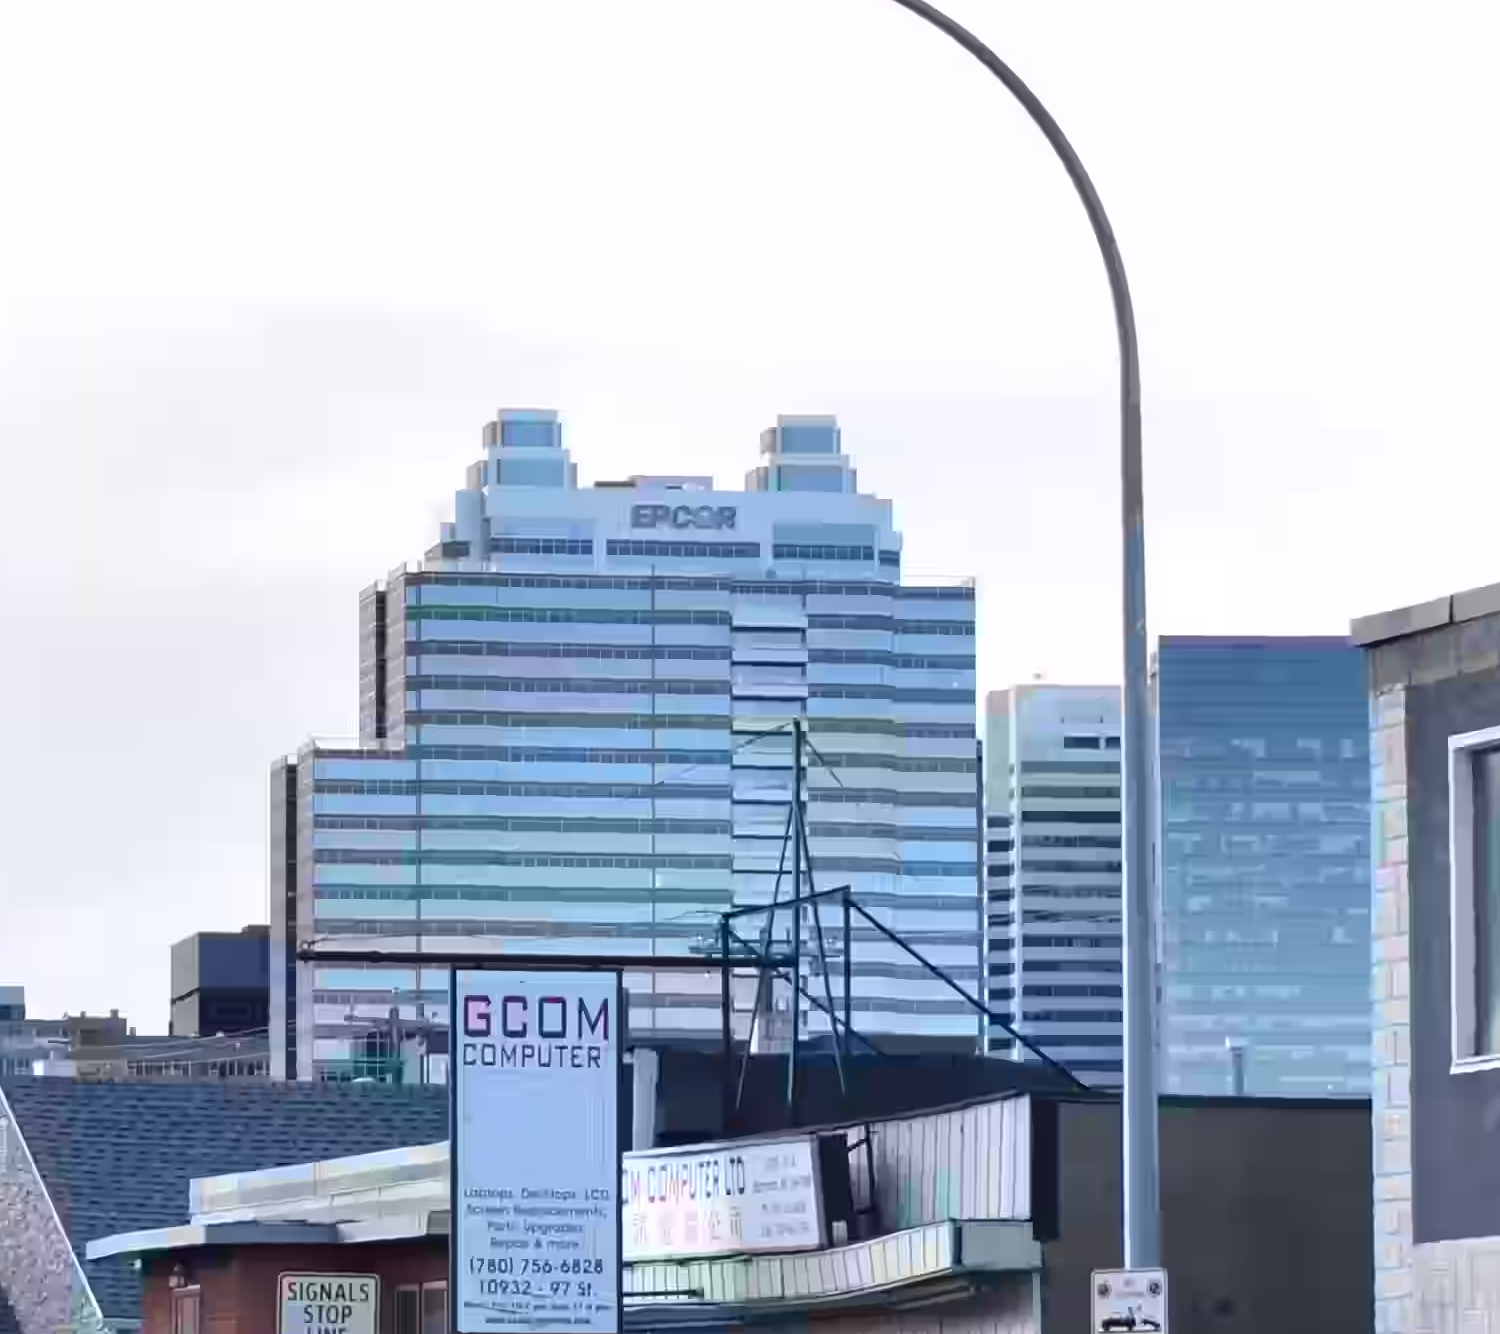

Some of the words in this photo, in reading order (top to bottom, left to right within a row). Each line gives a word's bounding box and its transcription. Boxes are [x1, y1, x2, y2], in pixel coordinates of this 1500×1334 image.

[631, 504, 737, 530] EPCOR
[463, 994, 610, 1041] GCOM
[463, 1043, 601, 1068] COMPUTER
[469, 1256, 513, 1274] (780)
[520, 1258, 604, 1275] 756-6828
[287, 1282, 369, 1302] SIGNALS
[480, 1278, 531, 1296] 10932
[550, 1280, 570, 1297] 97
[303, 1304, 353, 1324] STOP
